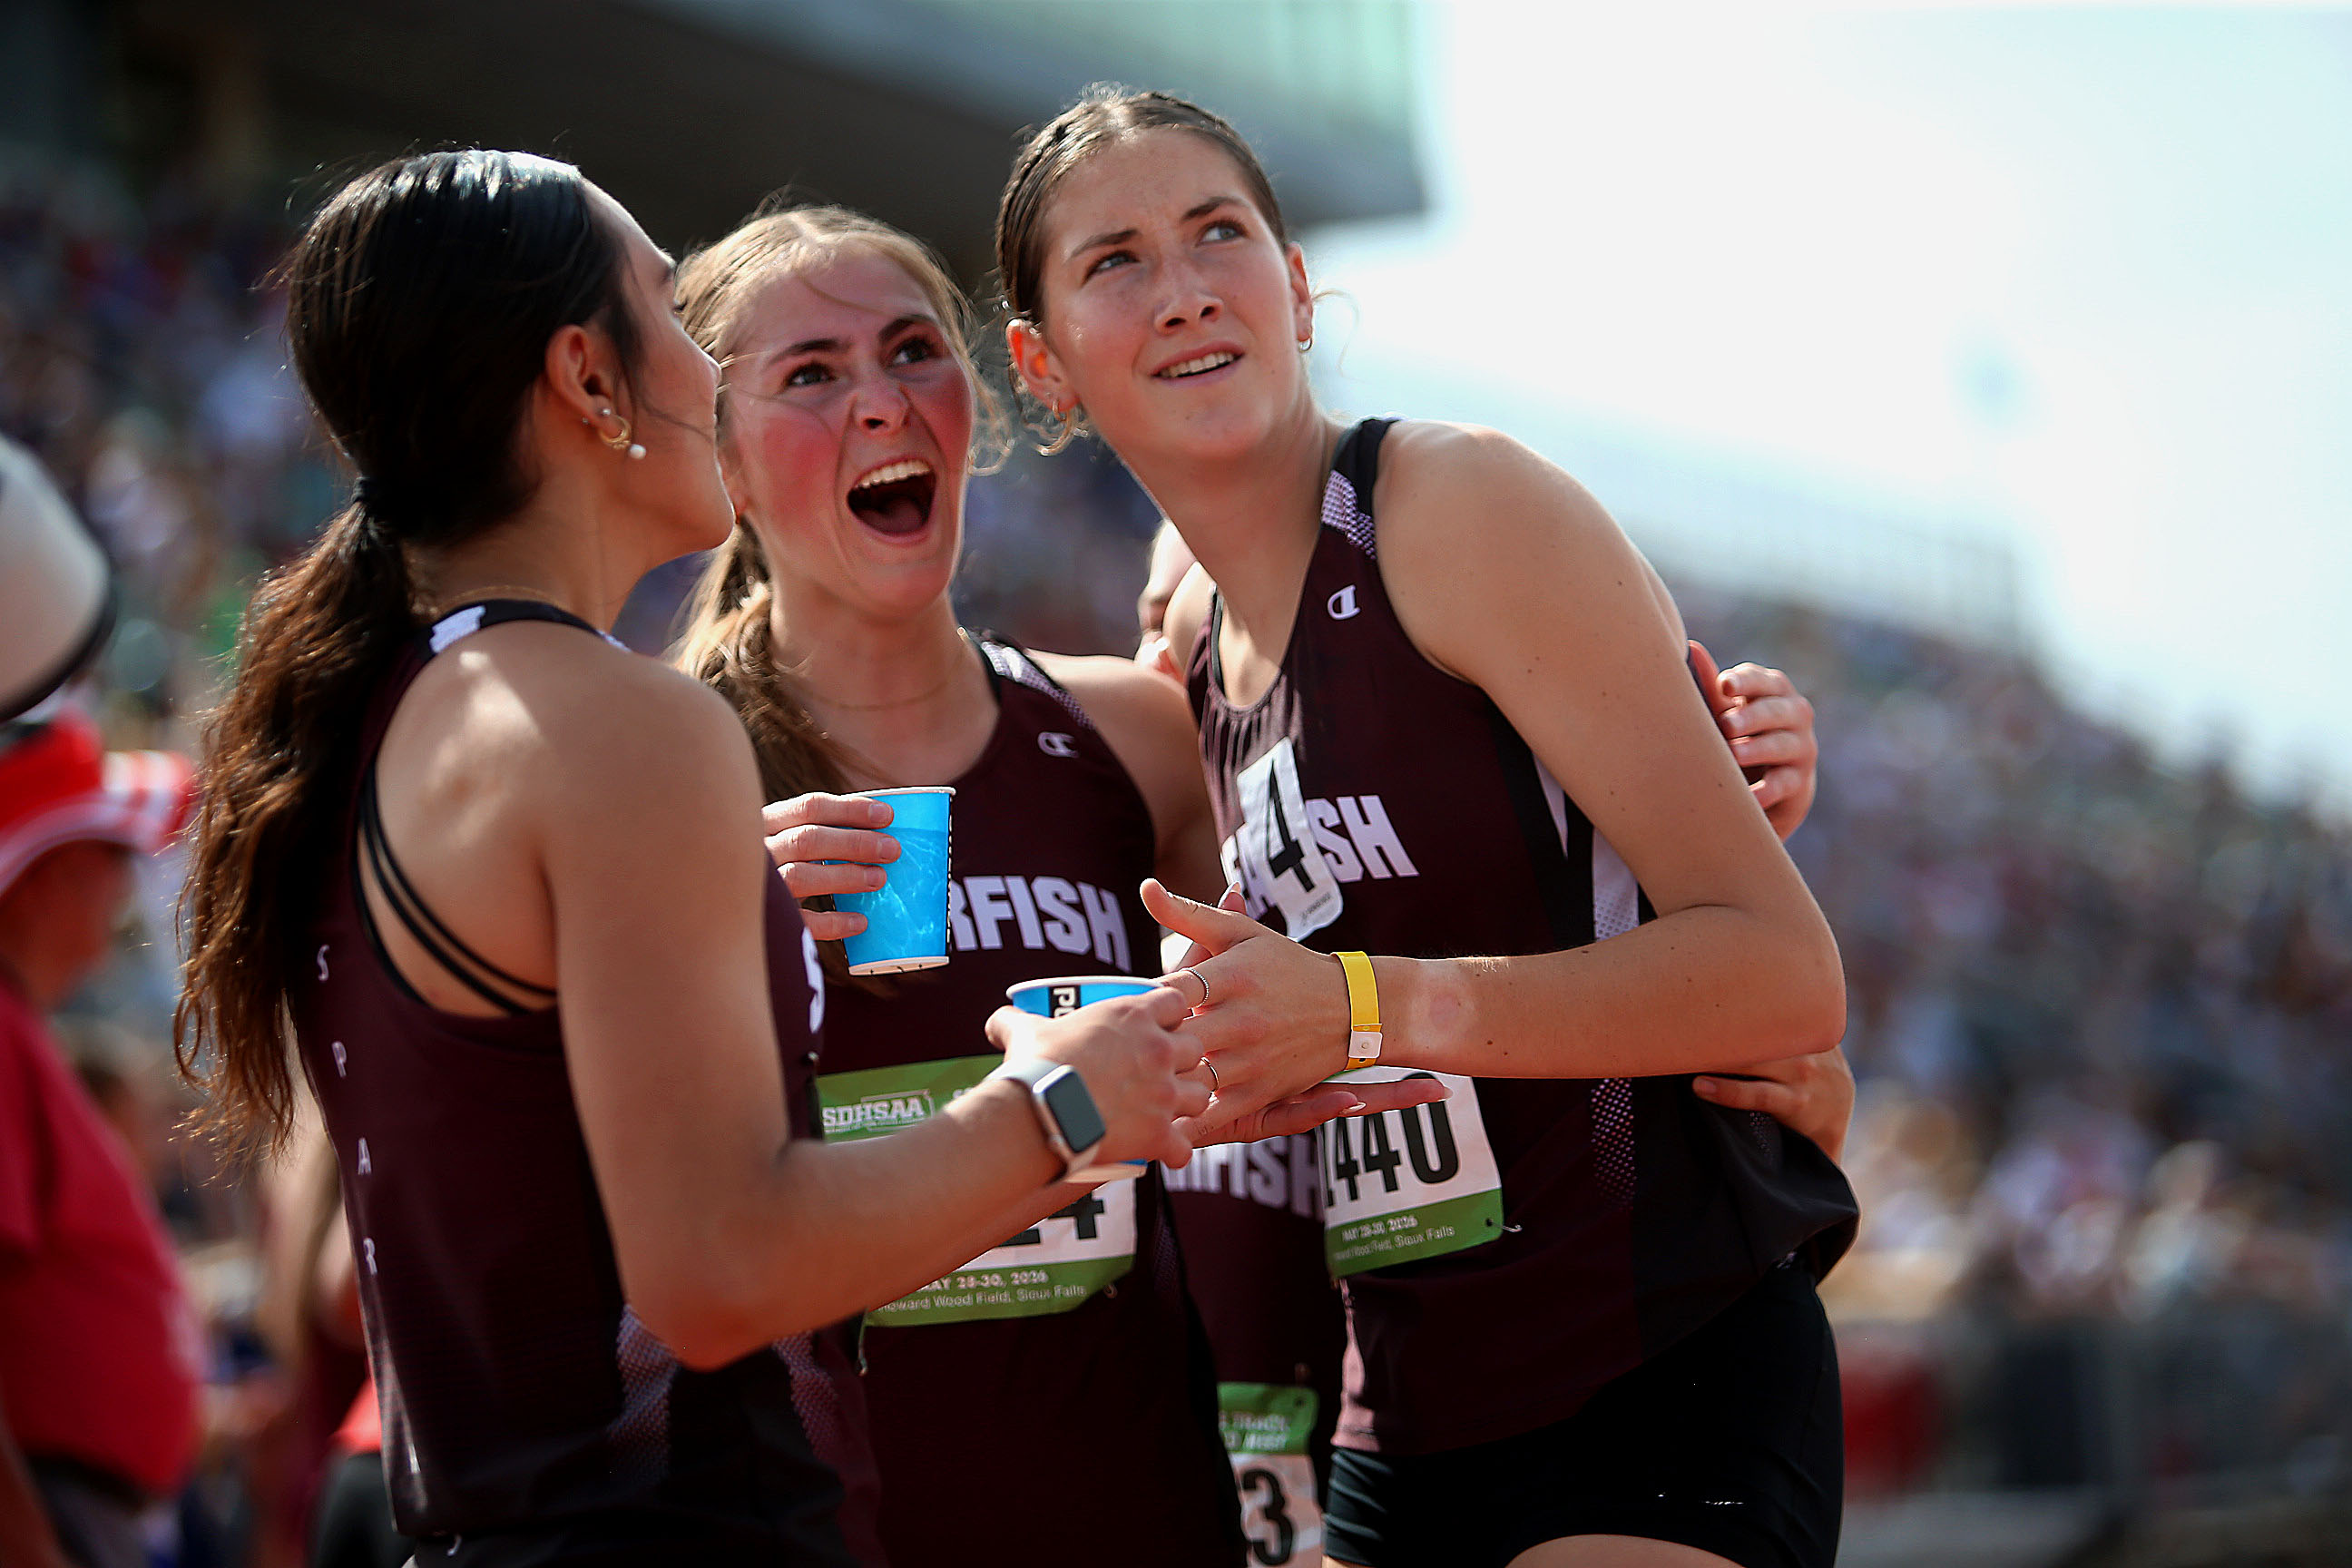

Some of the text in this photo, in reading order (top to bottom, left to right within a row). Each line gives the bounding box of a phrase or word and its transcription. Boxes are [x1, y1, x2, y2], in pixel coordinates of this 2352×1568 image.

[1268, 758, 1316, 893] 4
[822, 1097, 925, 1128] SDHSAA
[917, 1277, 952, 1292] AY
[932, 1290, 974, 1309] Wood
[1242, 1467, 1293, 1566] 3
